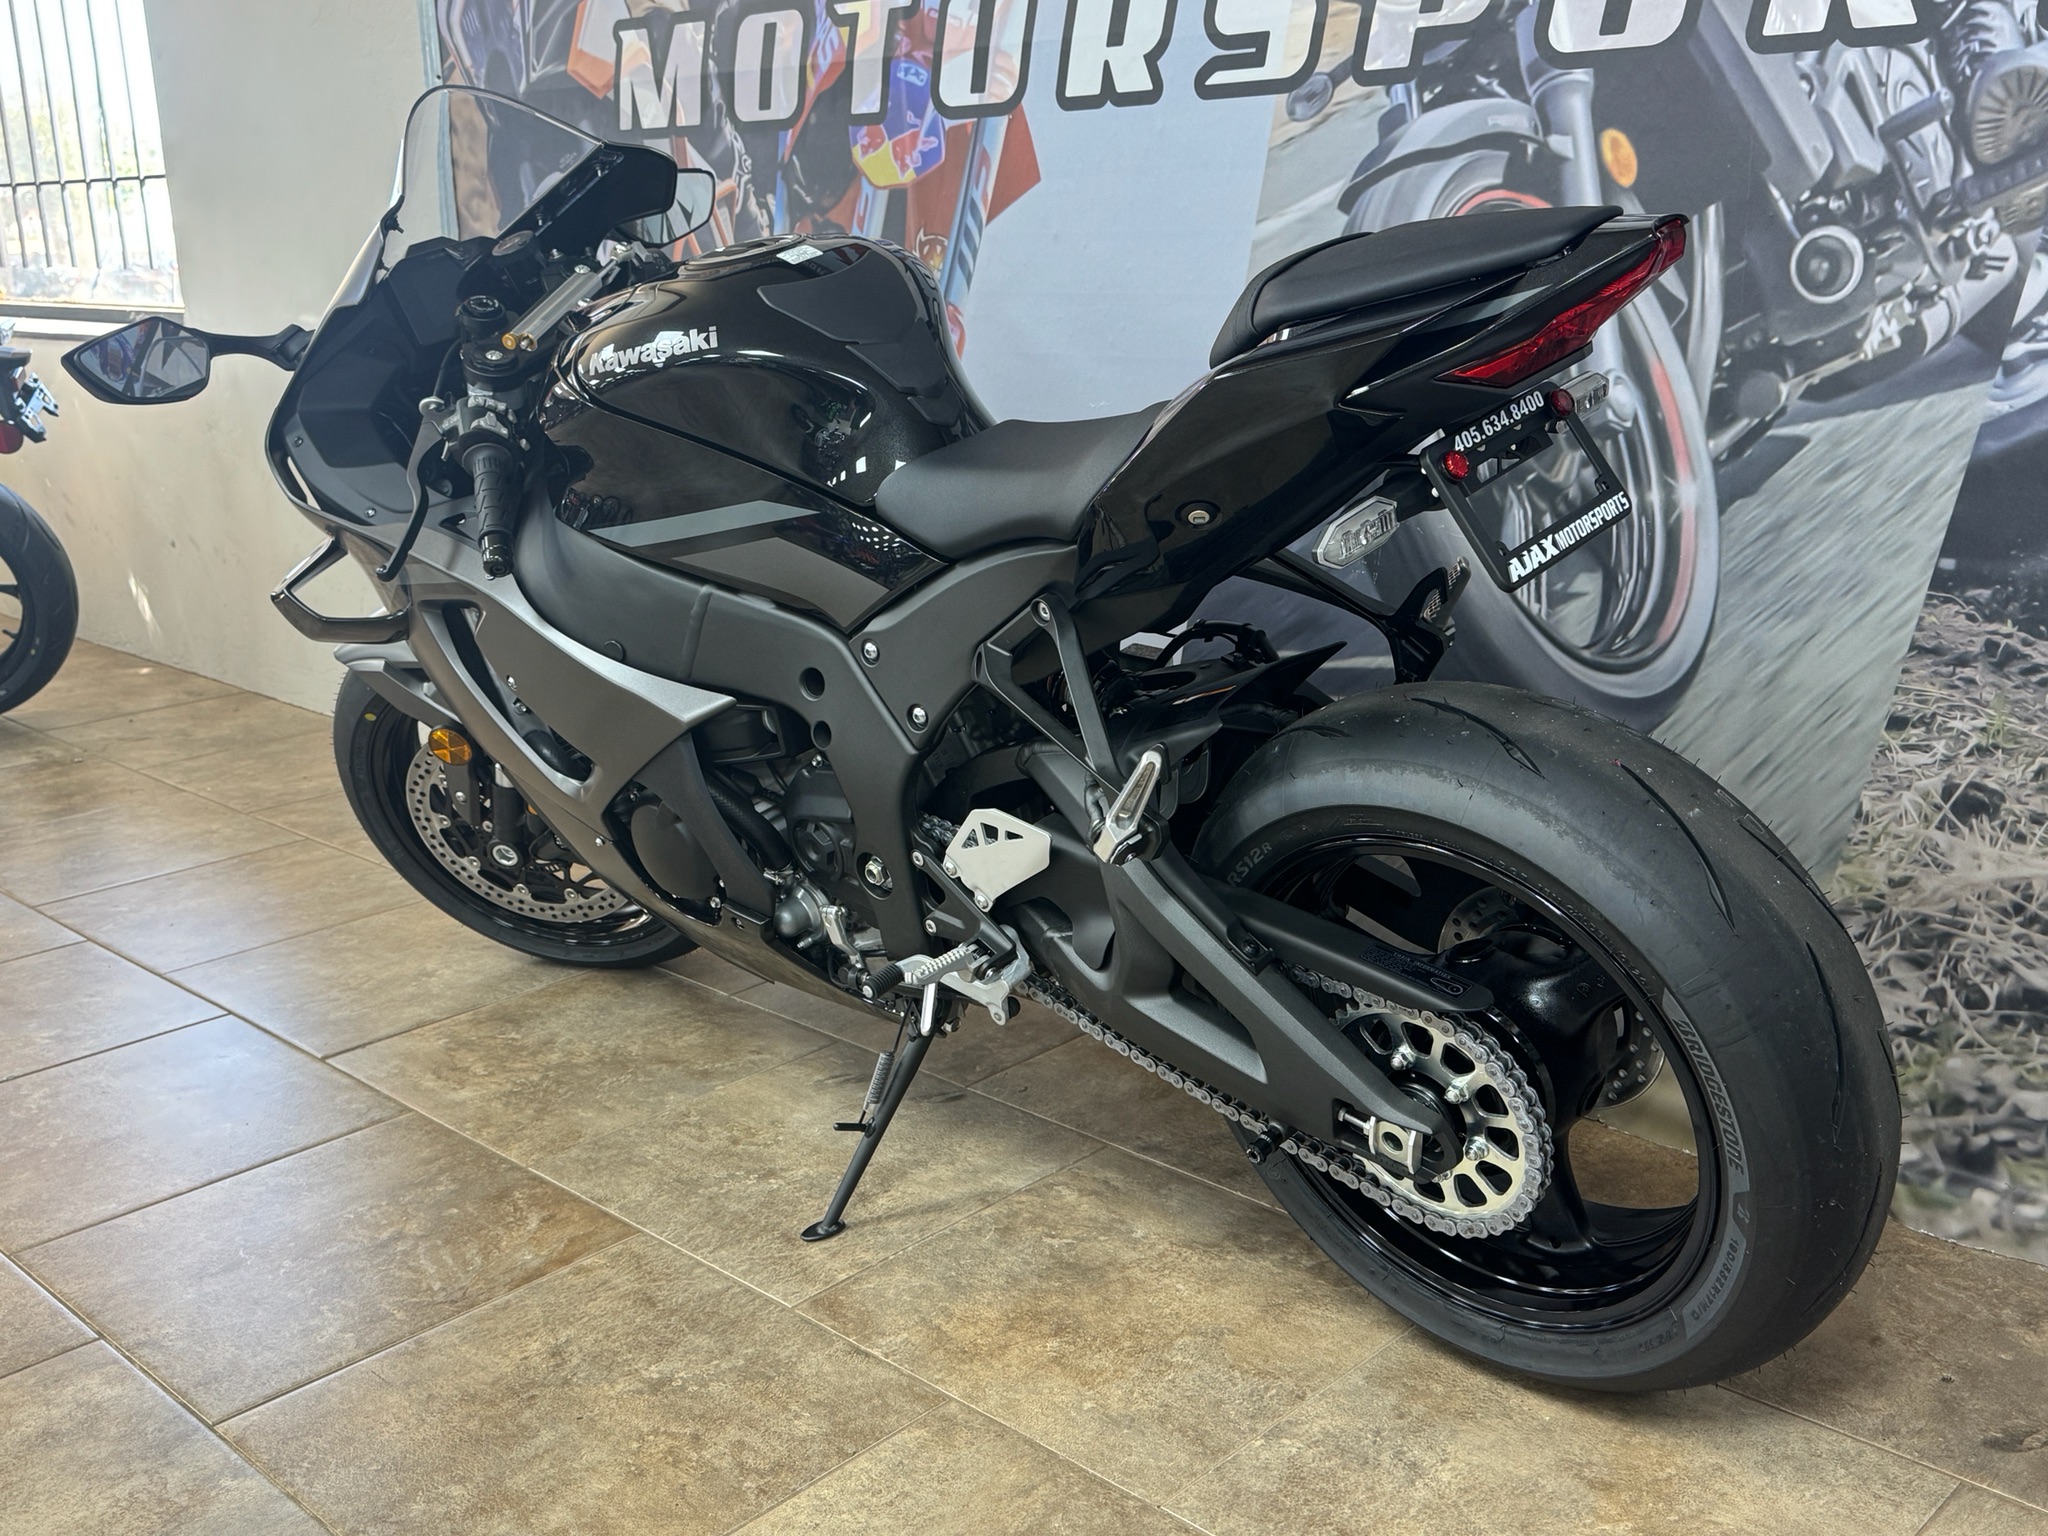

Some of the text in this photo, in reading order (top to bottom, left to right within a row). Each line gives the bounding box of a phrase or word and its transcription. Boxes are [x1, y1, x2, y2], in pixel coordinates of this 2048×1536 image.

[613, 0, 1931, 130] MOTORSP
[589, 325, 719, 376] Kawasaki
[1453, 390, 1545, 452] 405.634.8400
[1508, 491, 1630, 583] AJAX MOTORSPORTS
[1672, 1018, 1744, 1176] BRIDGESTONE
